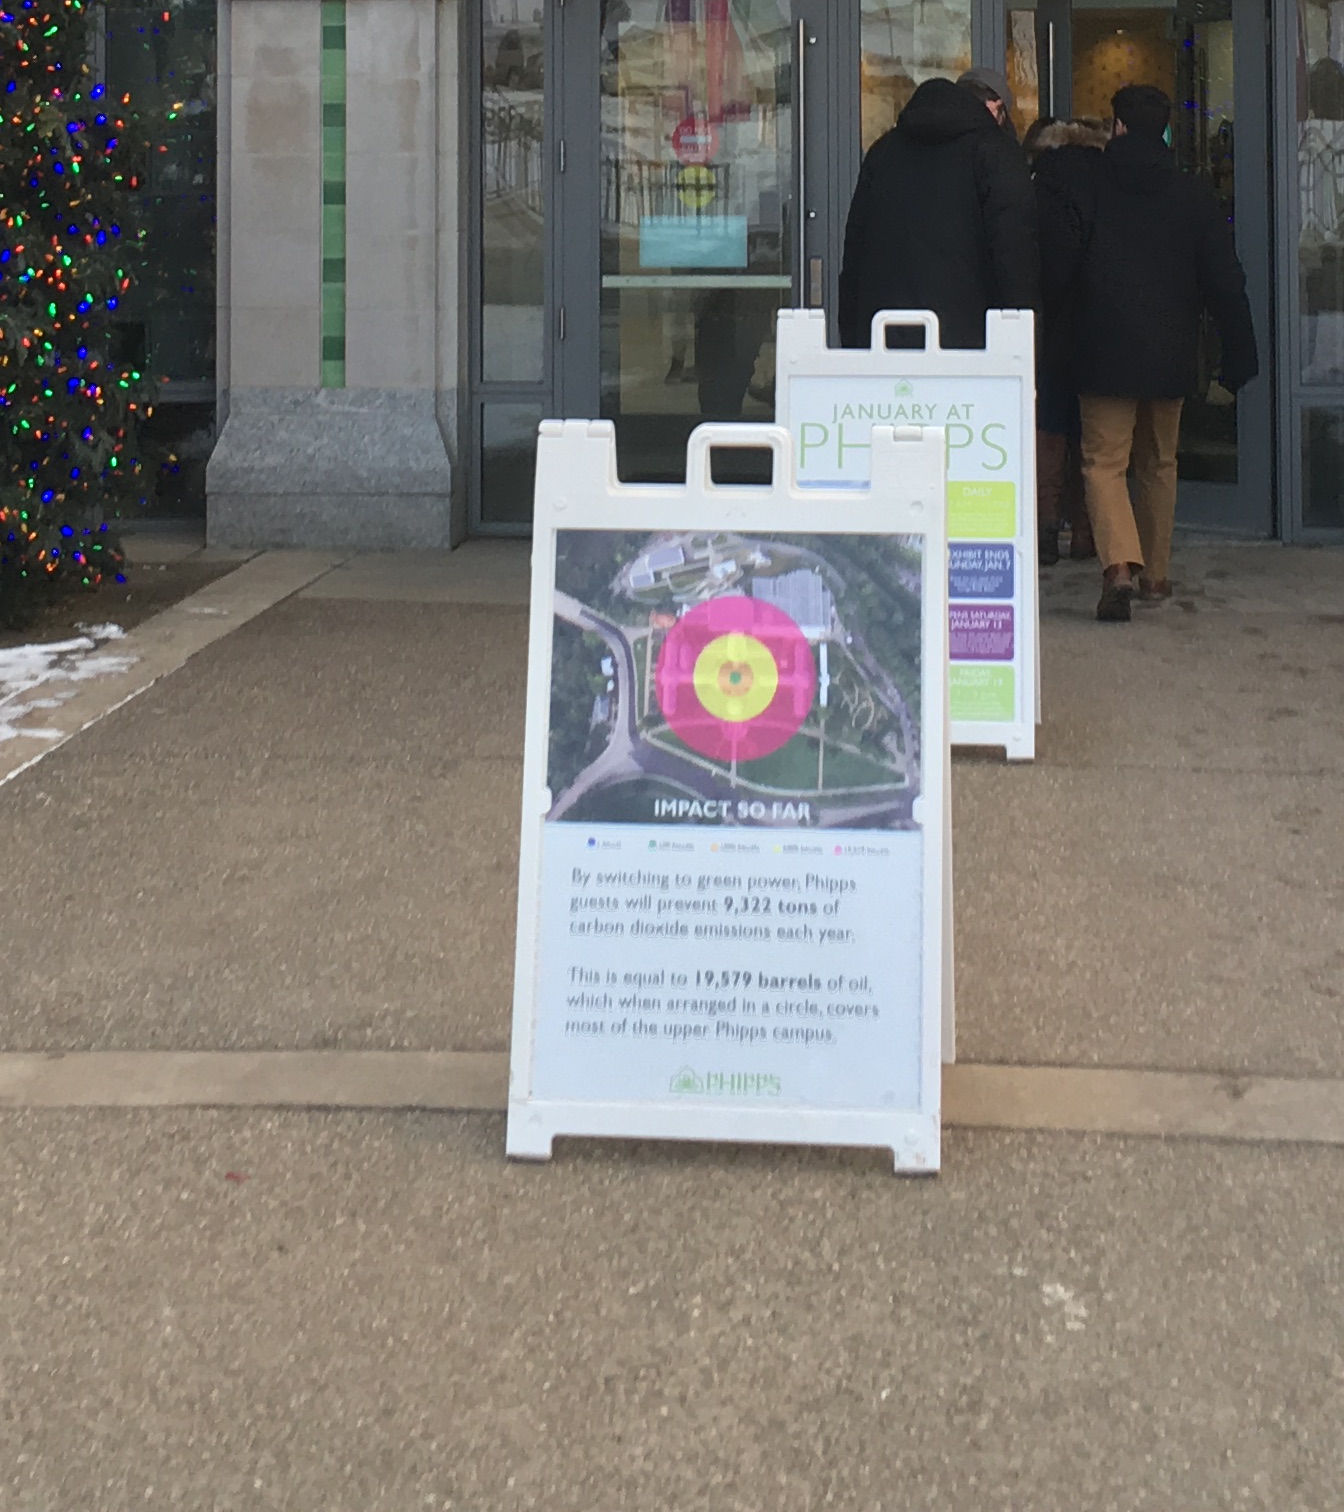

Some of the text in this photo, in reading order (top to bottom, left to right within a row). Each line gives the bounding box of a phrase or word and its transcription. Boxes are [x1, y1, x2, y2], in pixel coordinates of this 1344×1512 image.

[832, 403, 975, 423] JANUARY AT
[799, 422, 1009, 471] PHPS
[963, 488, 992, 497] DAILY
[984, 549, 1010, 559] ENDS
[951, 620, 990, 631] JANUARY
[654, 798, 811, 821] IMPACT SO FAR
[571, 867, 591, 890] By
[596, 868, 669, 892] switching
[675, 872, 692, 889] to
[697, 874, 742, 894] green
[805, 872, 857, 895] Phipps
[569, 894, 841, 917] guests will prevent 9,322 tons of
[569, 917, 856, 947] carbon dioxide emissions each year.
[568, 965, 873, 996] This is equal to 19,579 barrels of oil,
[566, 992, 881, 1021] which when arranged in a circle, covers
[565, 1017, 838, 1048] most of the upper Phipps campus.
[706, 1070, 783, 1096] PHIPPS
